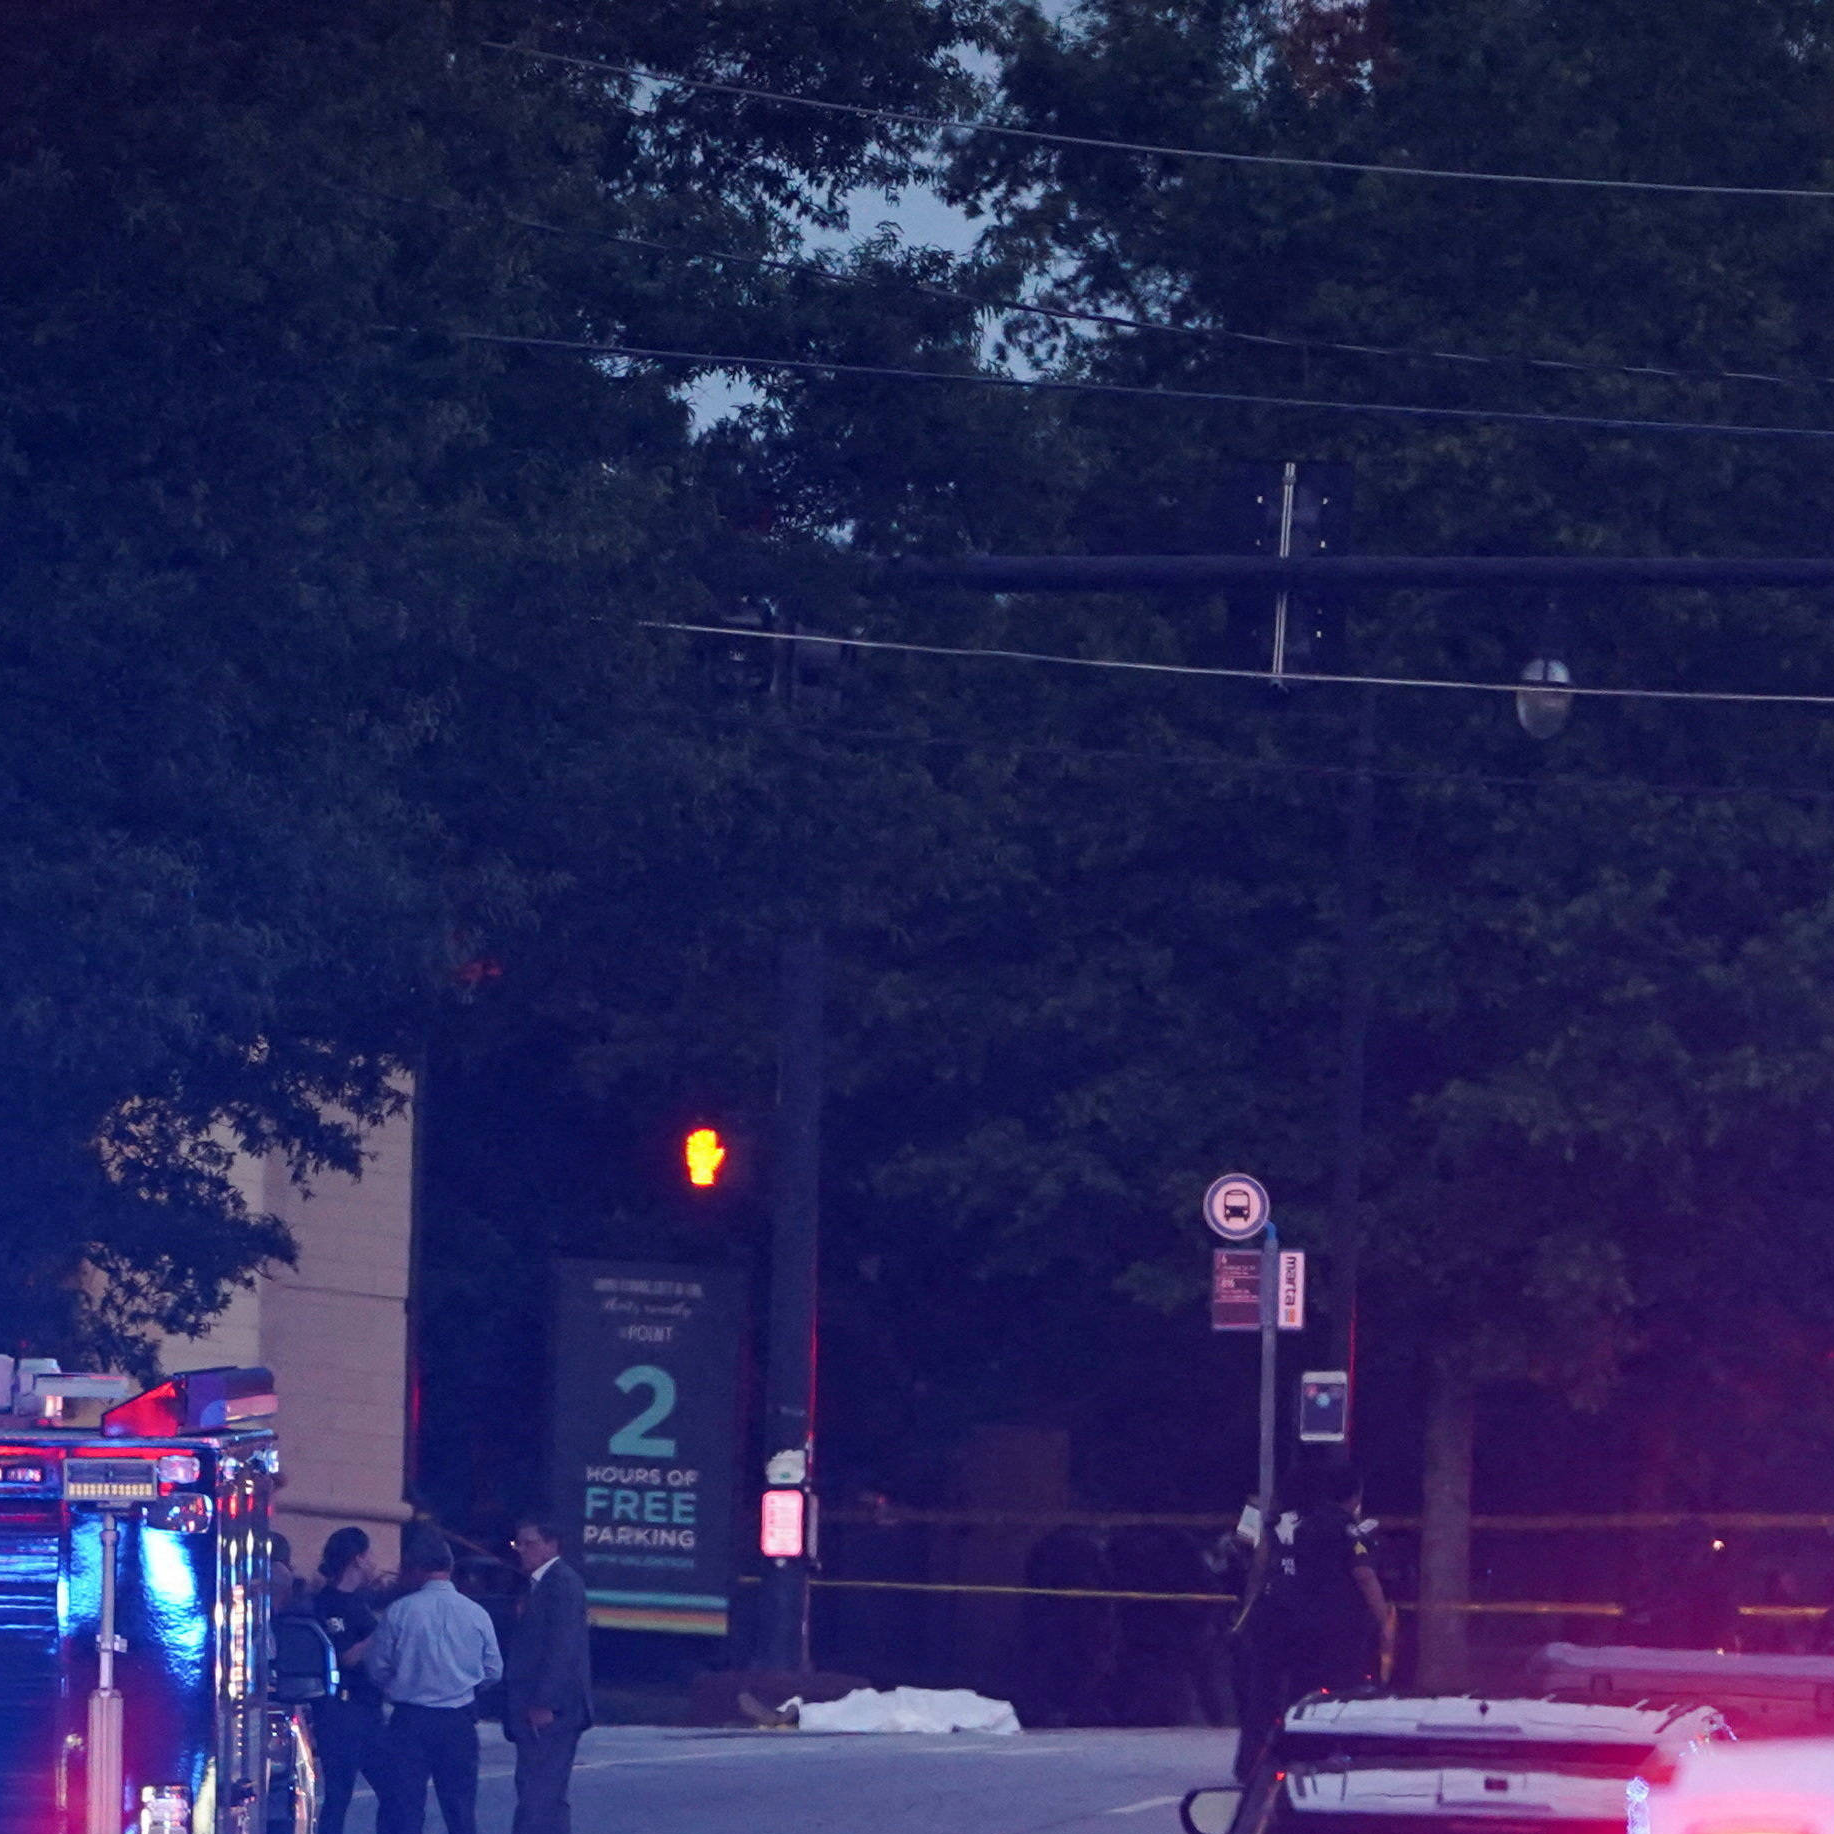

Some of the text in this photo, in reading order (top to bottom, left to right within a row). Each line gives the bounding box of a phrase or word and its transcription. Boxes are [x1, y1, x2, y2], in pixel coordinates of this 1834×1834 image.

[1285, 1256, 1296, 1306] marta
[608, 1365, 676, 1458] 2
[586, 1466, 699, 1487] HOURS OF
[585, 1487, 696, 1524] FREE
[583, 1525, 695, 1550] PARKING
